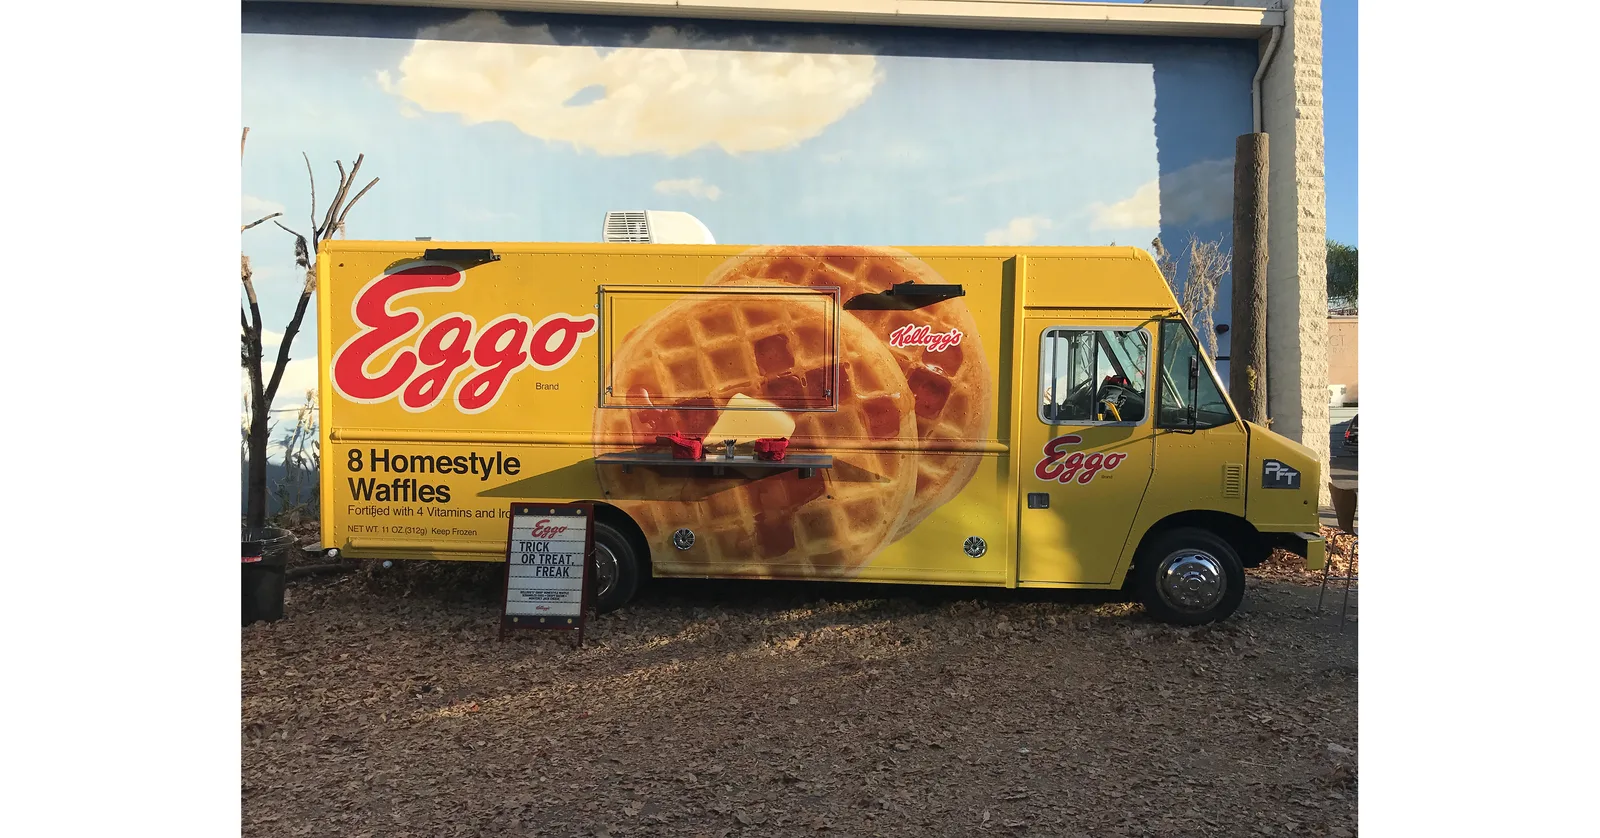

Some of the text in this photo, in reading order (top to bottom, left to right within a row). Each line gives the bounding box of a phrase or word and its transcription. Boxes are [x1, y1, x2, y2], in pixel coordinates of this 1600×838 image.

[331, 263, 598, 414] Eggo
[890, 324, 962, 352] Kellogg's
[535, 382, 559, 391] Brand
[347, 449, 521, 481] 8 Homestyle
[1035, 434, 1127, 484] Eggo
[1265, 461, 1297, 485] PFT
[347, 477, 451, 503] Waffles
[392, 507, 414, 517] with
[416, 507, 424, 517] 4
[426, 507, 472, 518] Vitamins
[475, 508, 495, 518] and
[498, 509, 511, 519] Iro
[347, 525, 364, 533] NET
[365, 525, 380, 533] WT.
[431, 527, 451, 537] Keep
[451, 528, 478, 537] Frozen
[531, 519, 567, 539] Eggo
[519, 542, 549, 552] TRICK
[521, 553, 575, 566] OR TREAT,
[535, 566, 570, 577] FREAK
